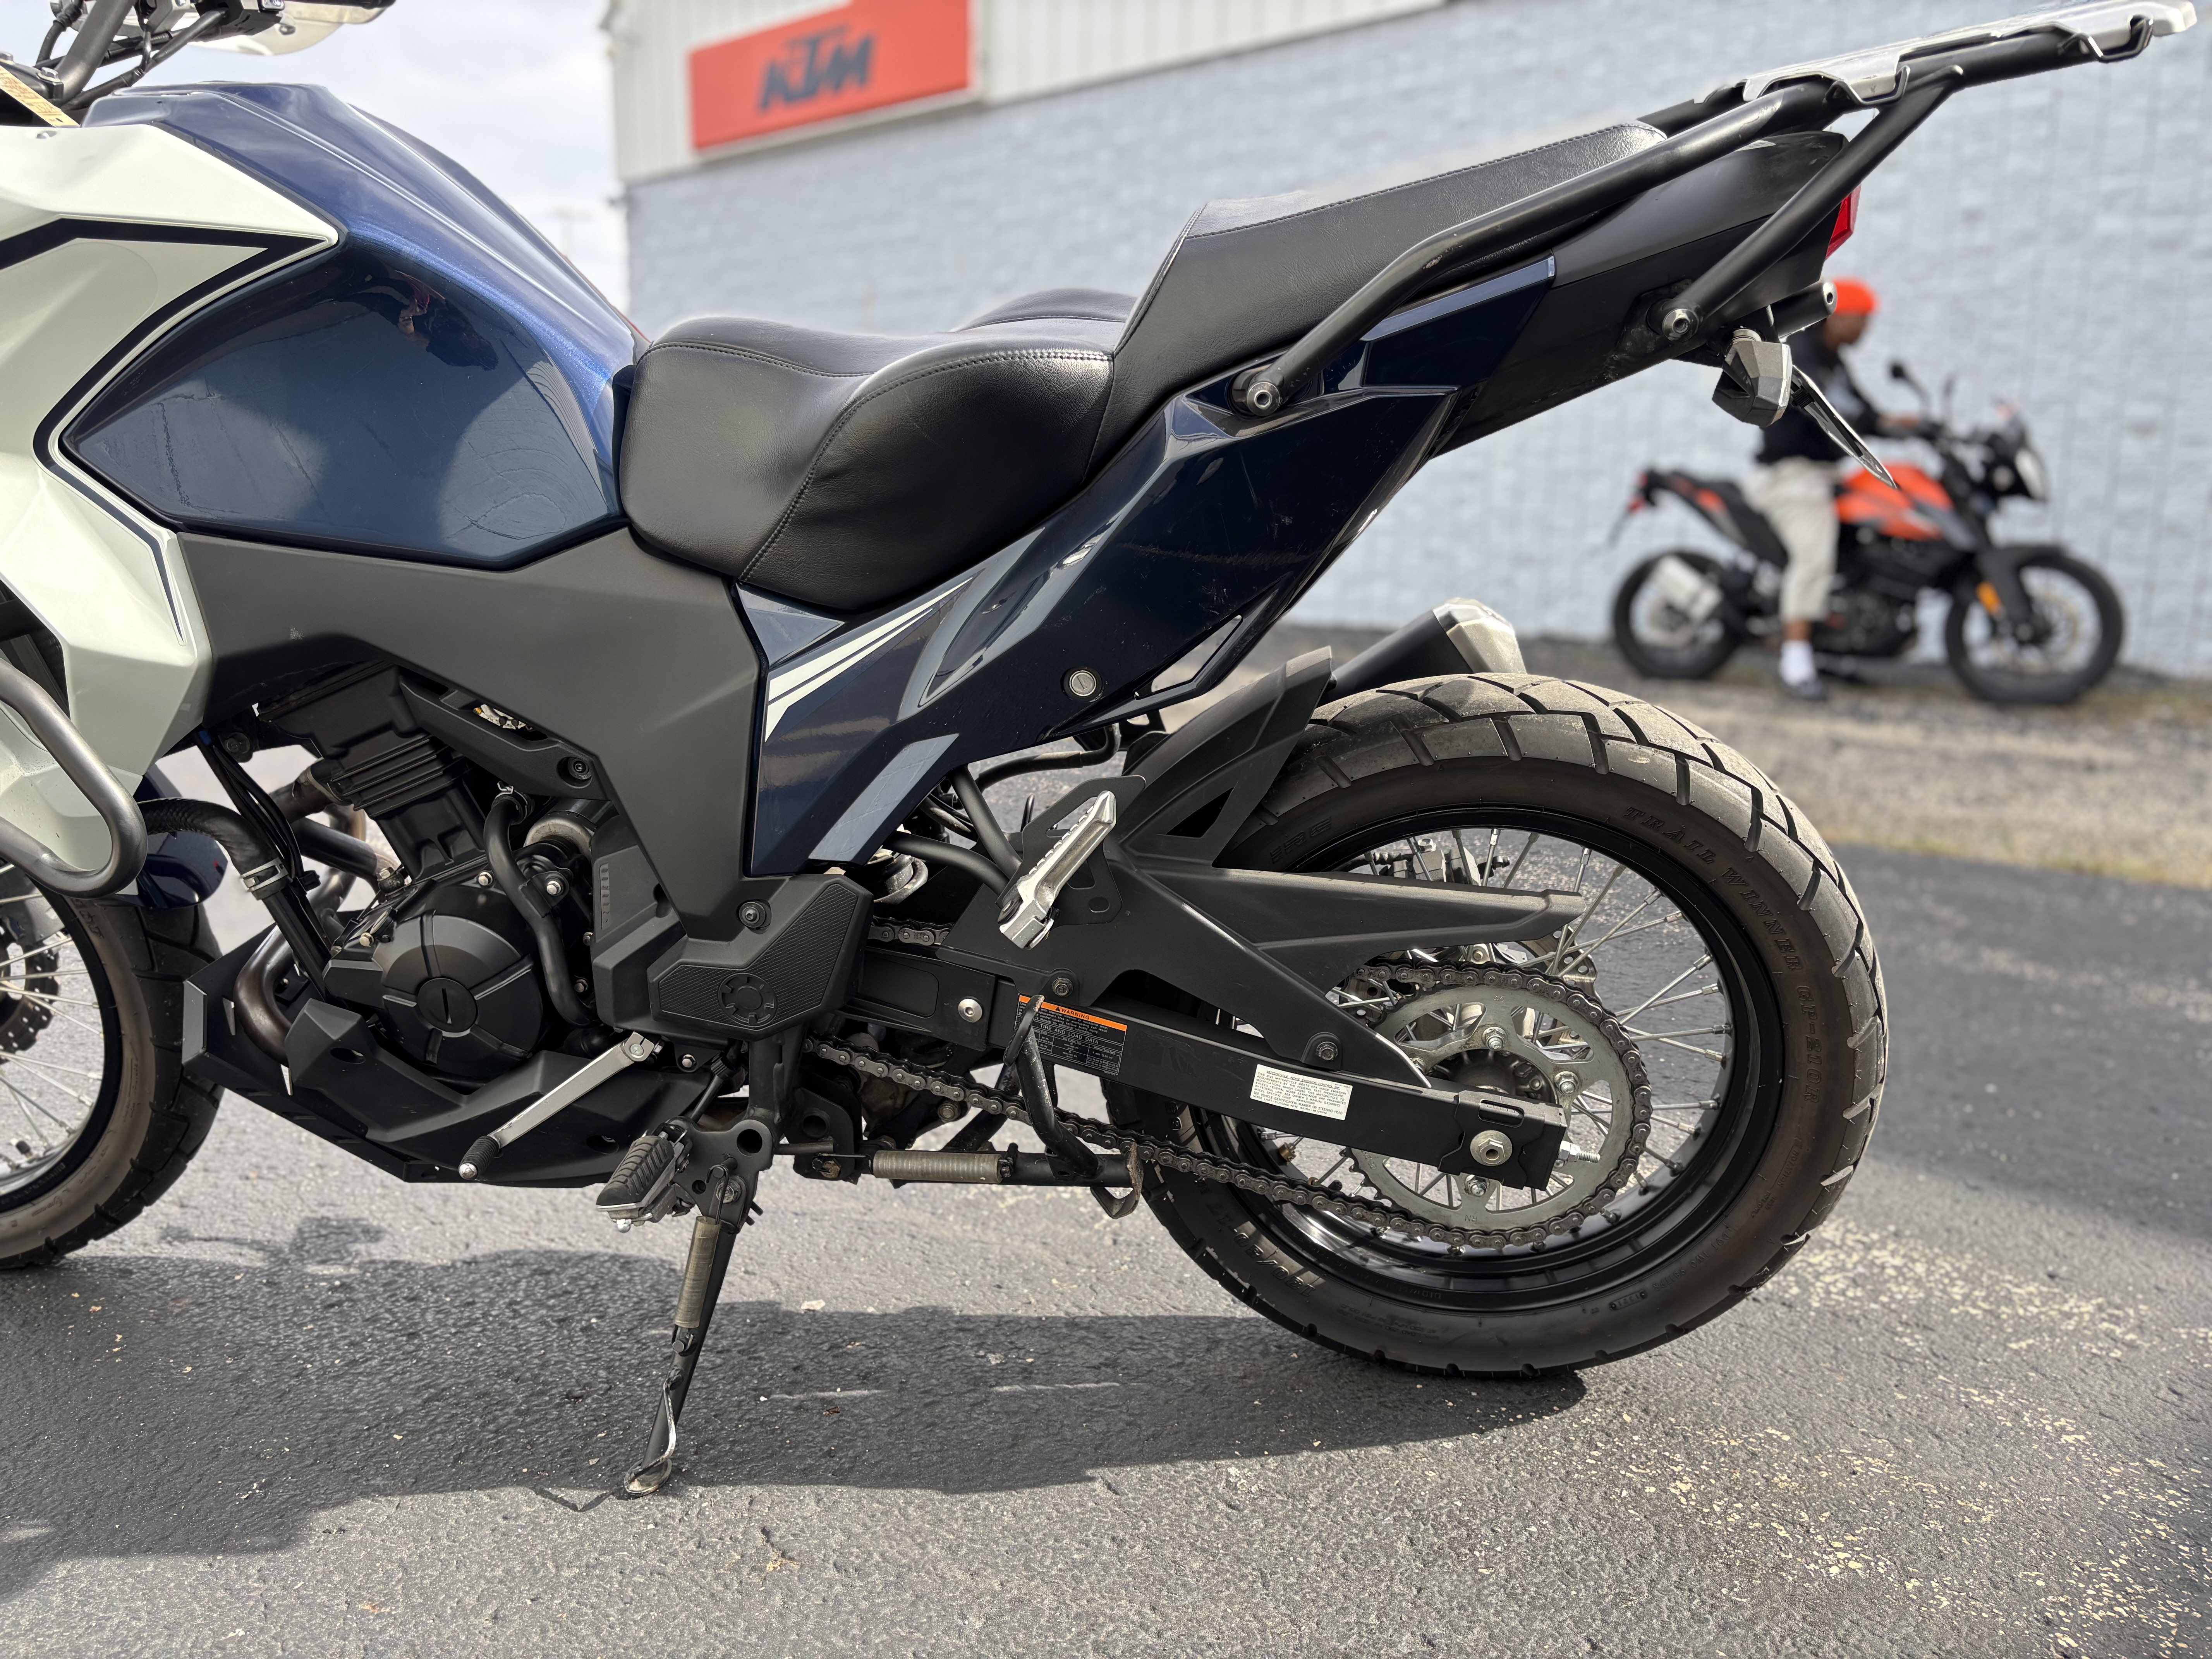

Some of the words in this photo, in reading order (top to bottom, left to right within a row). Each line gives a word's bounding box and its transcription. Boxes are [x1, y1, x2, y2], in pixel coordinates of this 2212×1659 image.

[757, 23, 878, 112] KTM
[1623, 805, 1716, 865] TRAIL
[1720, 867, 1804, 972] WINNER
[1061, 1008, 1090, 1020] WARNING
[1257, 1075, 1281, 1084] REQUIREMENTS
[1778, 1150, 1798, 1187] ROTATION
[1711, 1231, 1731, 1252] DOT
